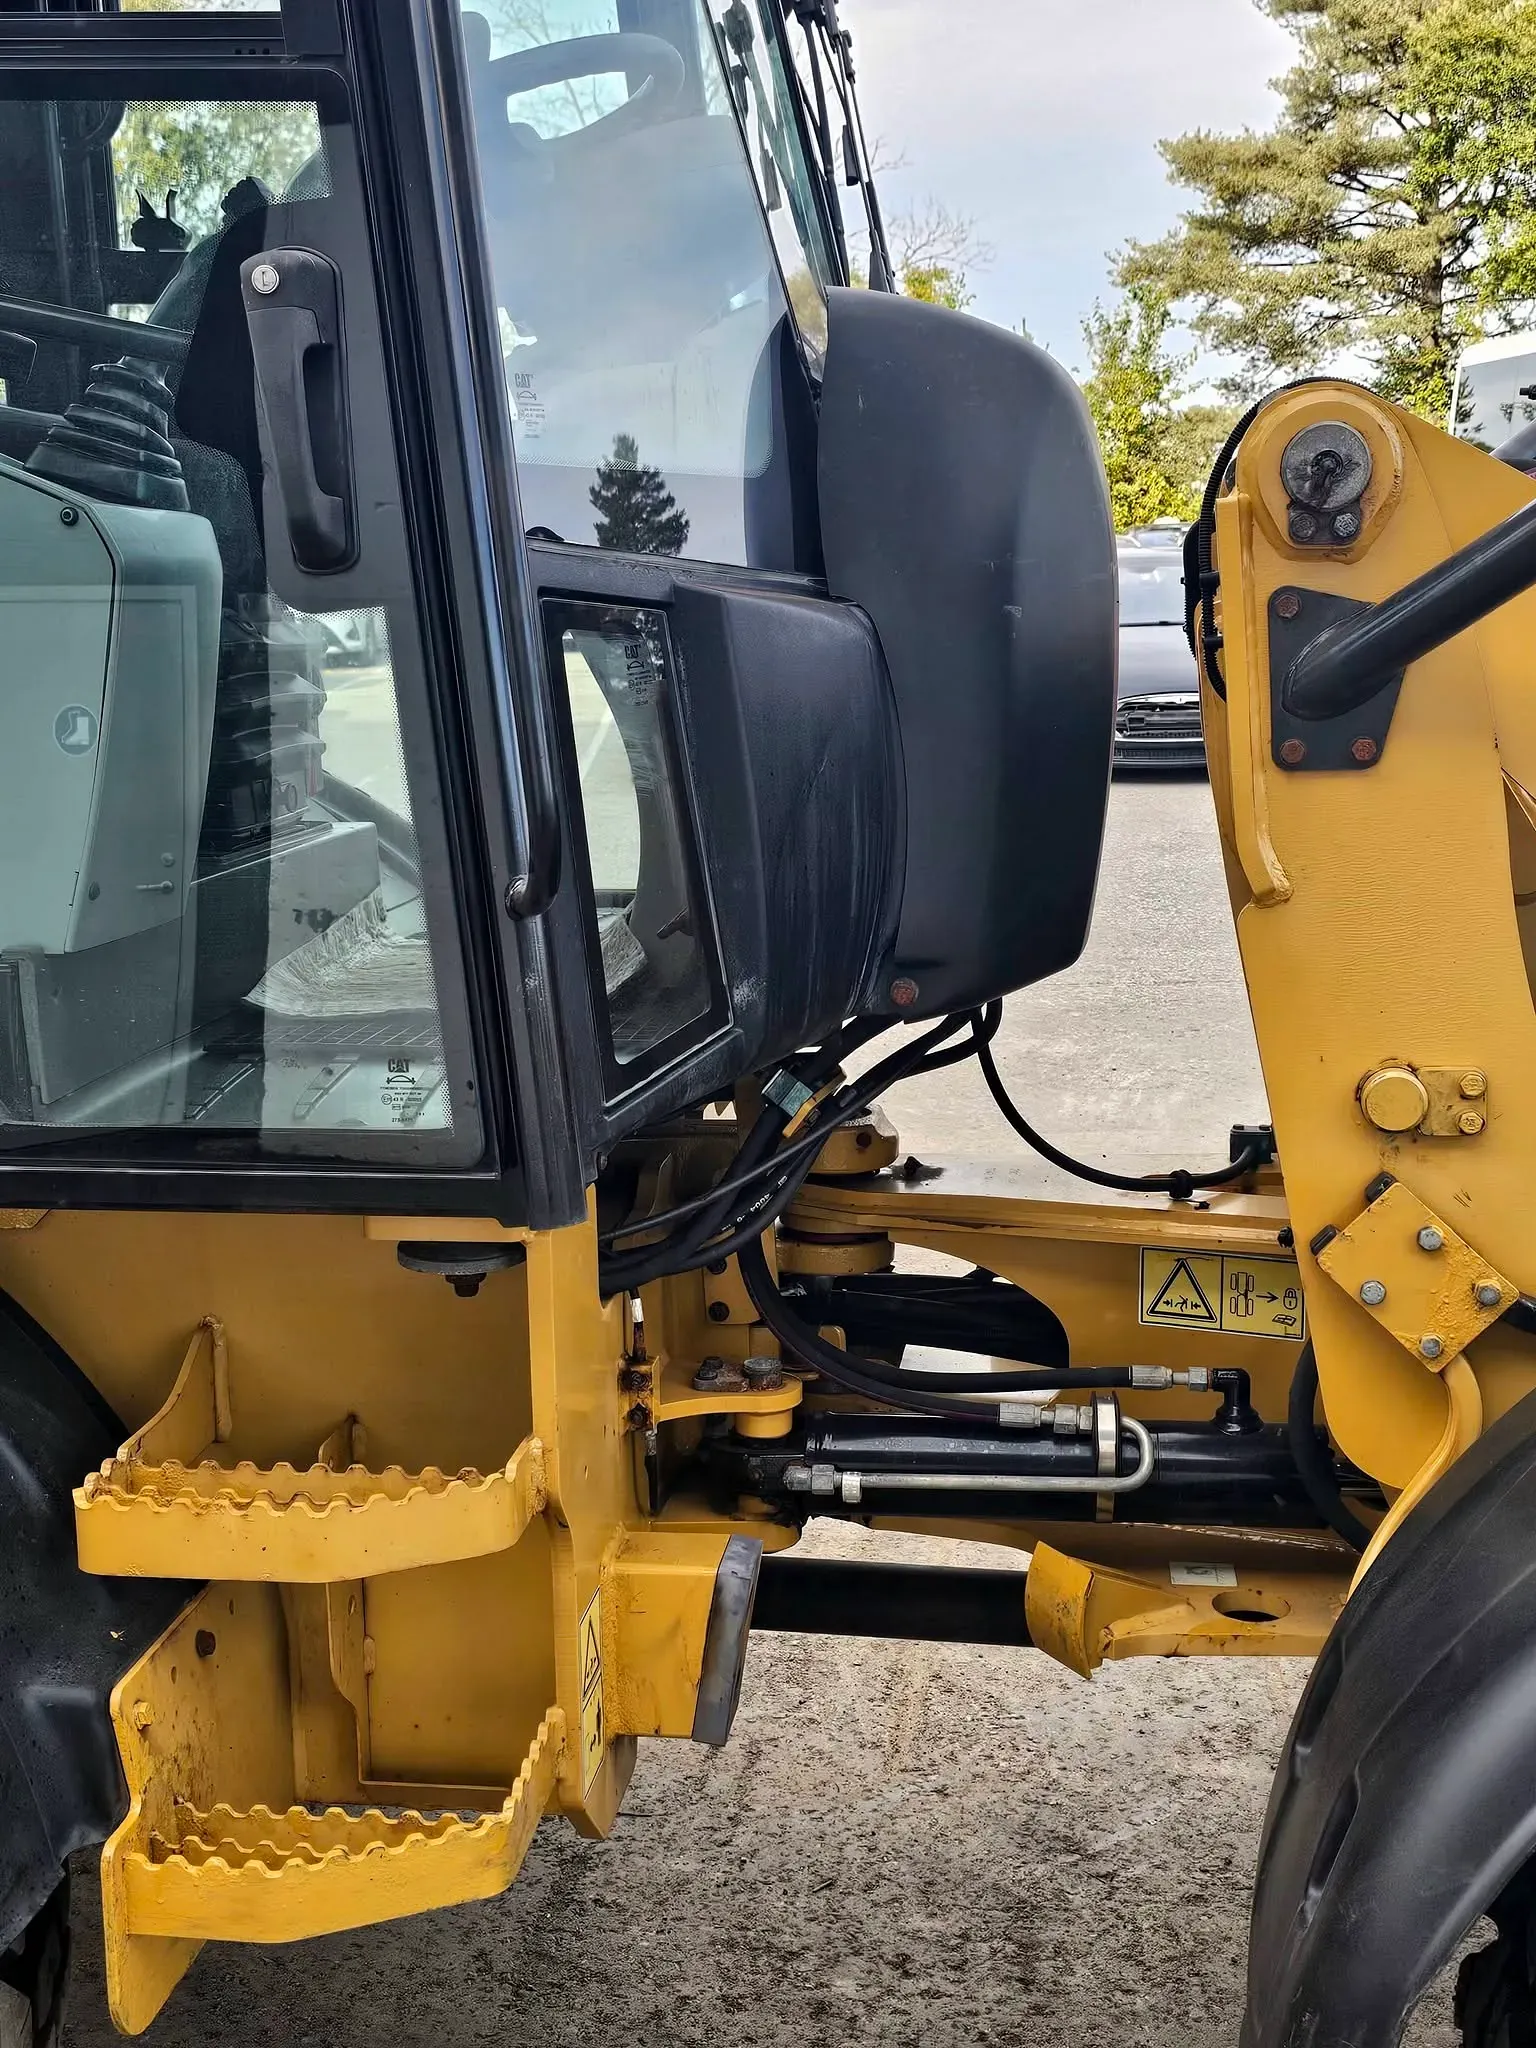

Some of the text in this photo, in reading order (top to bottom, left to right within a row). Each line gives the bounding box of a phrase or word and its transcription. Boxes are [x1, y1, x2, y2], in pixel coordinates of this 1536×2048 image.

[515, 373, 532, 388] CAT
[625, 644, 641, 659] CAT
[388, 1059, 410, 1073] CAT
